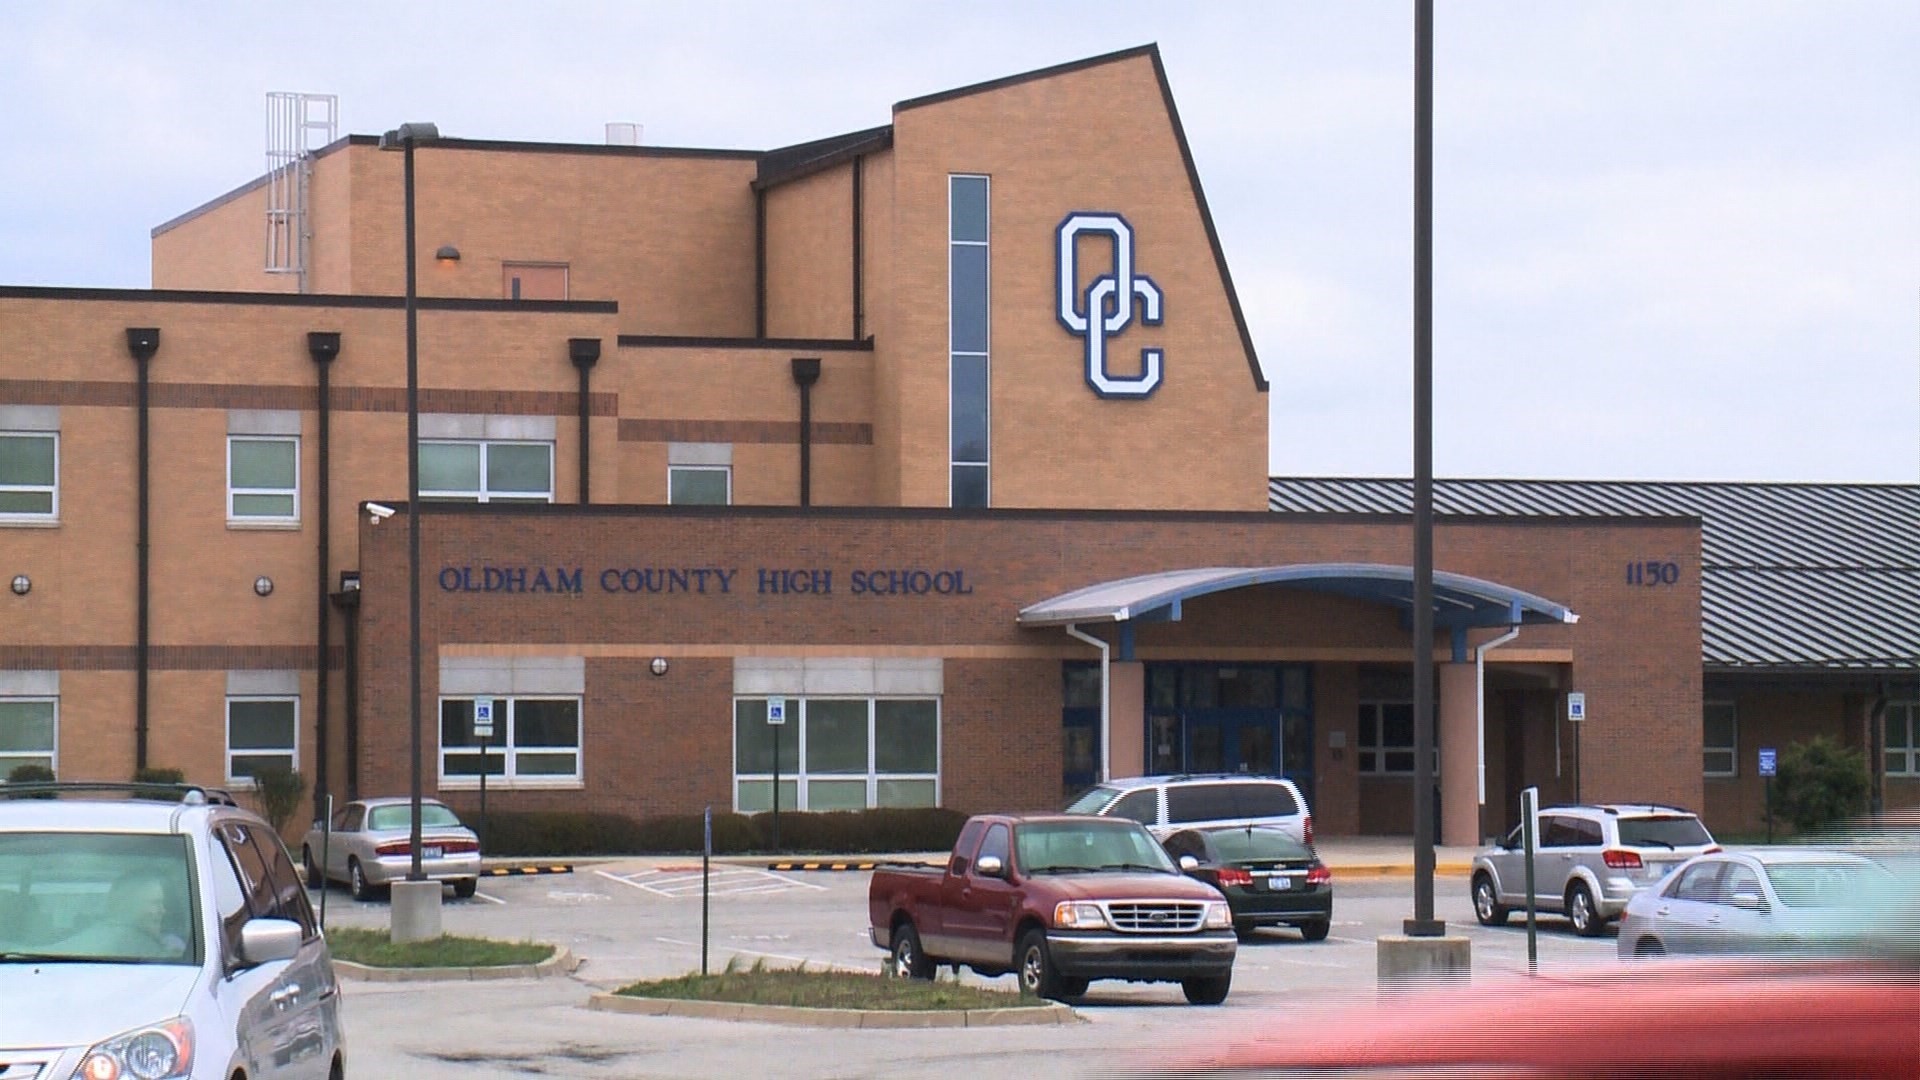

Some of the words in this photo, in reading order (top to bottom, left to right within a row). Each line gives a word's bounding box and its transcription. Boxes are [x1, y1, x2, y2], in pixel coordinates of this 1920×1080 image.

[439, 567, 583, 593] OLDHAM
[600, 568, 737, 593] COUNTY
[757, 569, 832, 594] HIGH
[851, 570, 973, 595] SCHOOL
[1626, 561, 1679, 587] 1150
